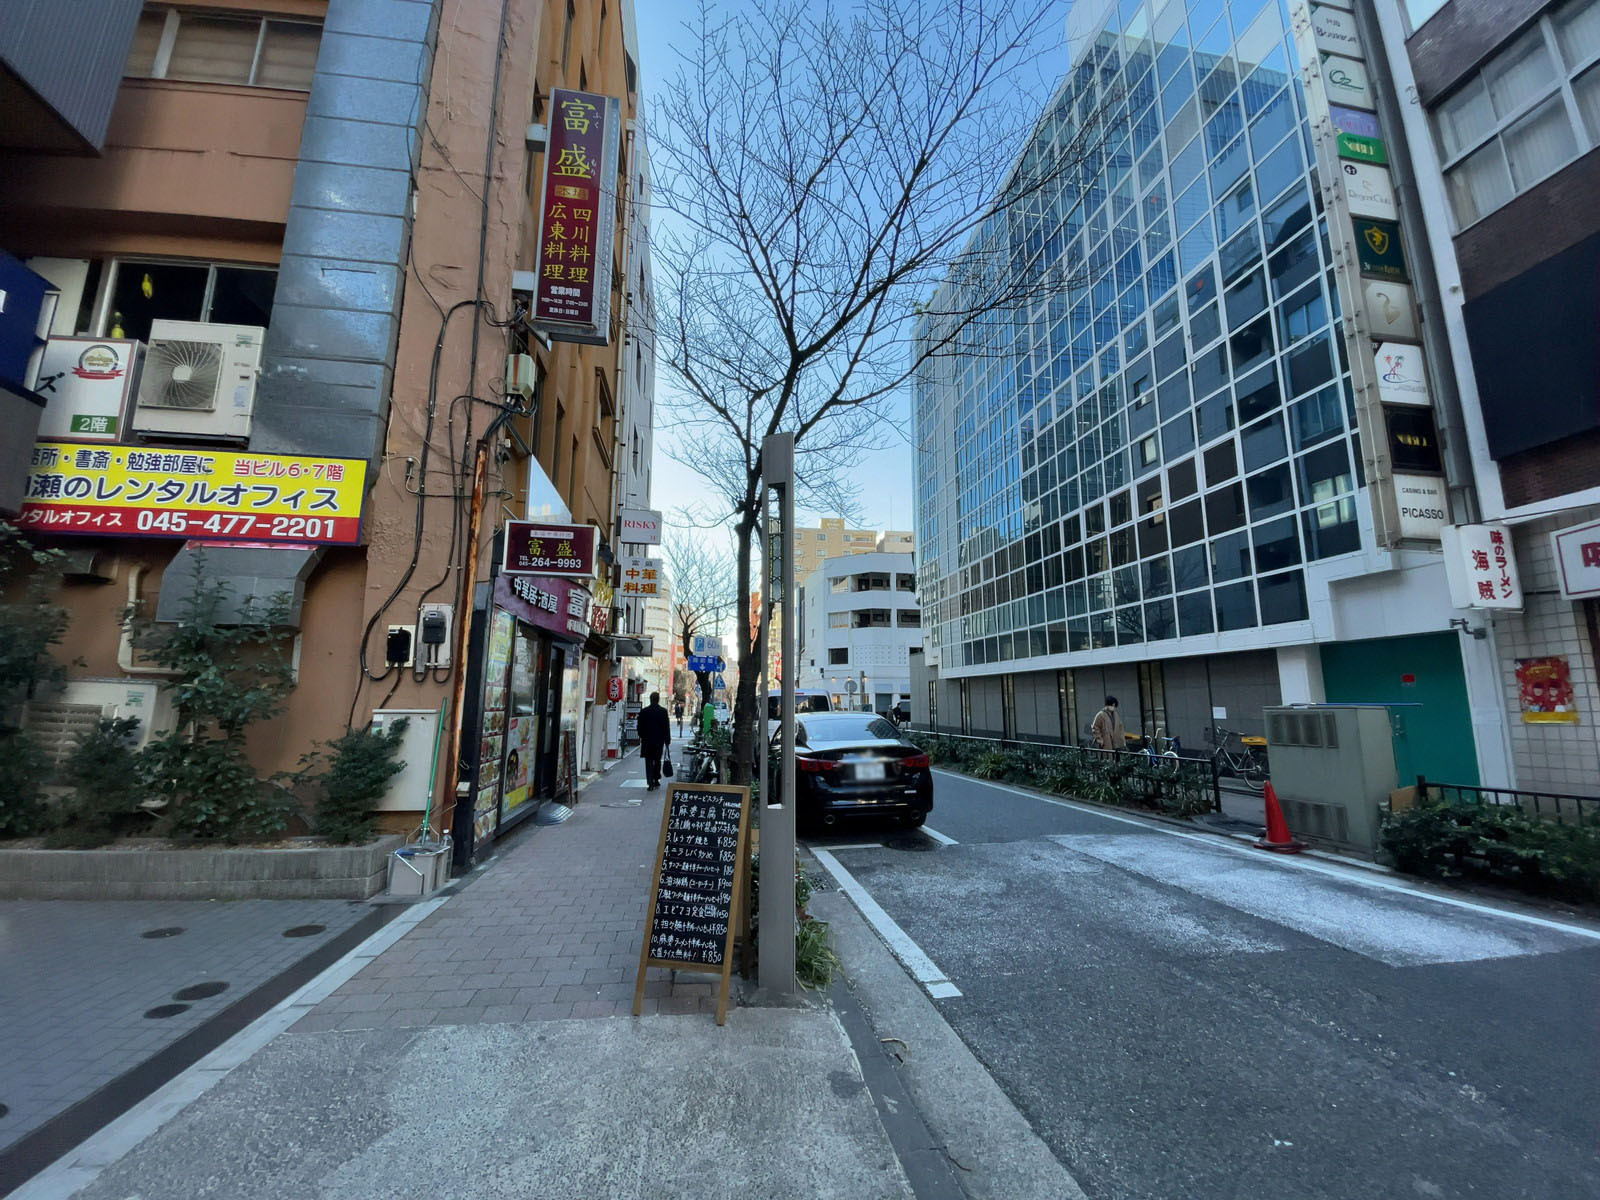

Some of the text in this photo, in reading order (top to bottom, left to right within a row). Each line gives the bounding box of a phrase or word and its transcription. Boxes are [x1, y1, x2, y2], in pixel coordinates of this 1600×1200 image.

[552, 98, 596, 179] 富盛
[543, 202, 567, 280] 広東料理
[568, 208, 592, 283] 四川料理
[80, 416, 108, 432] 2階
[137, 510, 335, 538] 045-477-2201
[624, 519, 657, 529] RISKY
[1401, 507, 1444, 520] PICASSO
[625, 568, 658, 580] 中華
[1489, 530, 1512, 598] 味のラーメン
[513, 576, 558, 614] 中華居酒屋
[624, 582, 657, 594] 料理
